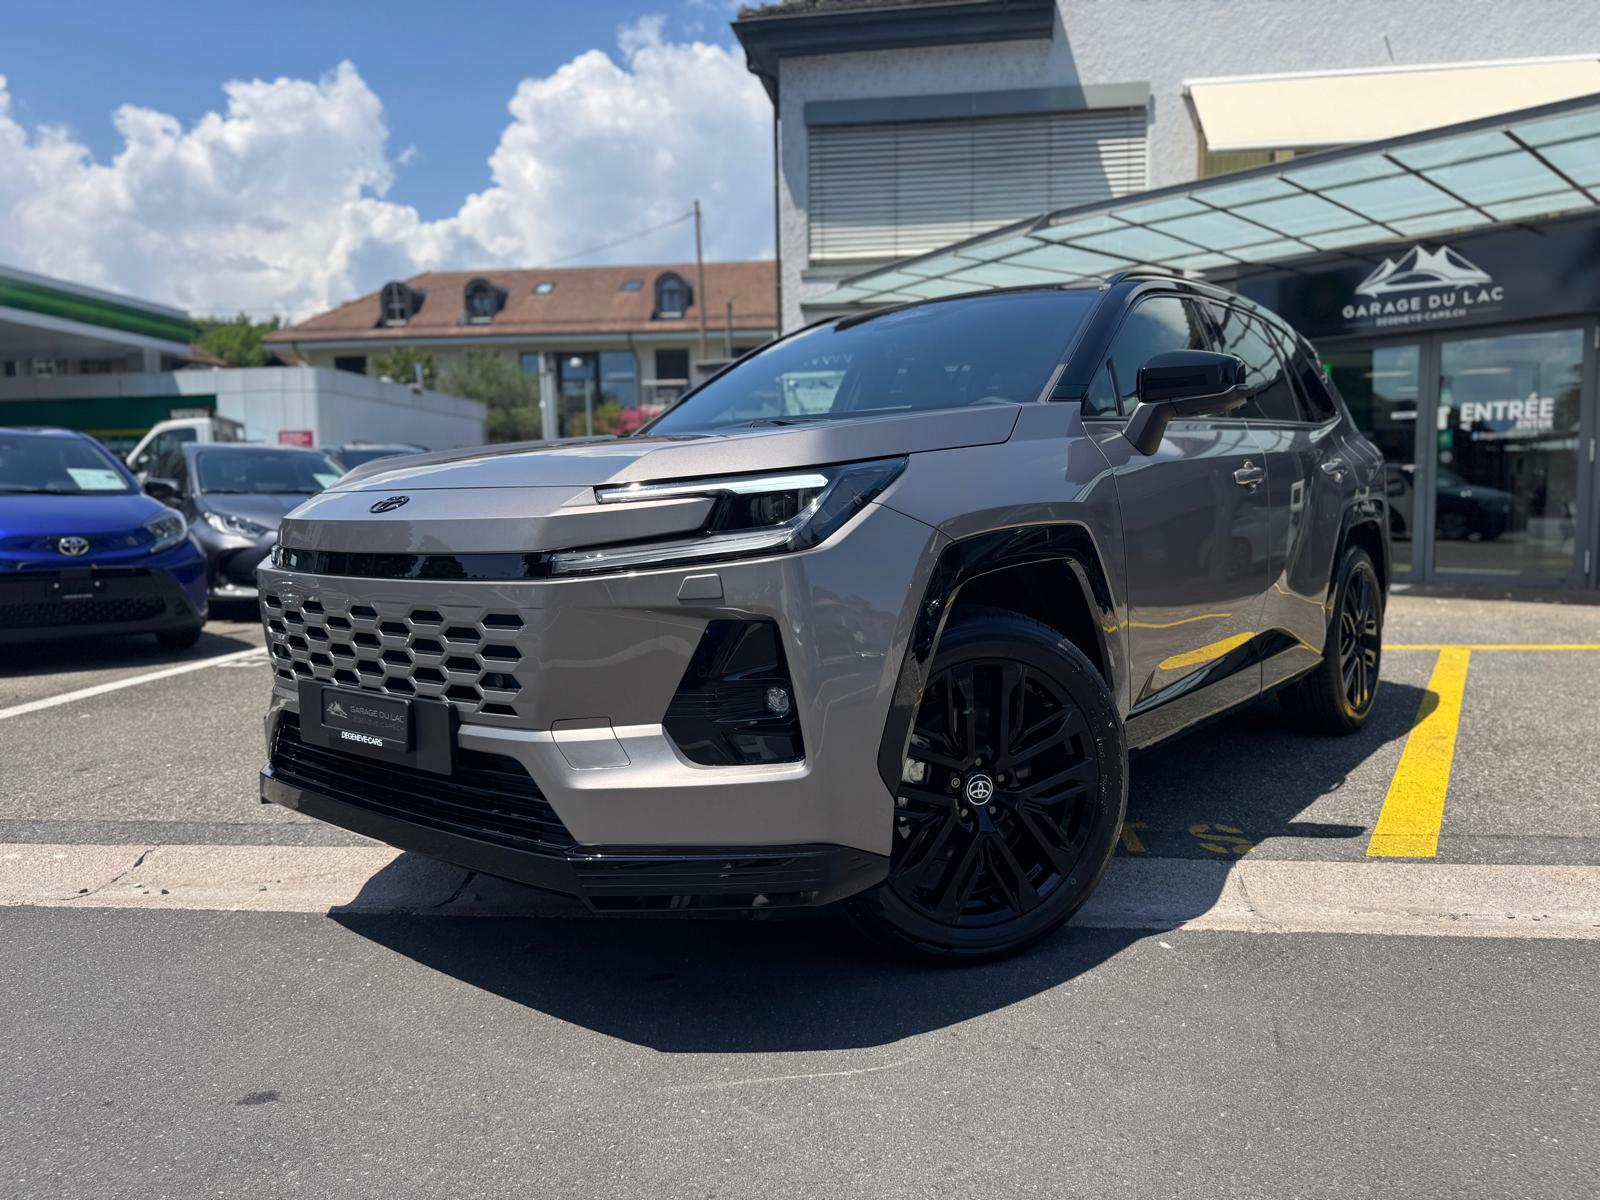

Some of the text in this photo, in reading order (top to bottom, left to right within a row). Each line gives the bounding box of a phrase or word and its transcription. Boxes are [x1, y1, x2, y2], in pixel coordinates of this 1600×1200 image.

[1342, 286, 1504, 318] GARAGE DU LAC
[1460, 392, 1555, 421] ENTRÉE
[350, 706, 405, 724] GARAGE DU LAC
